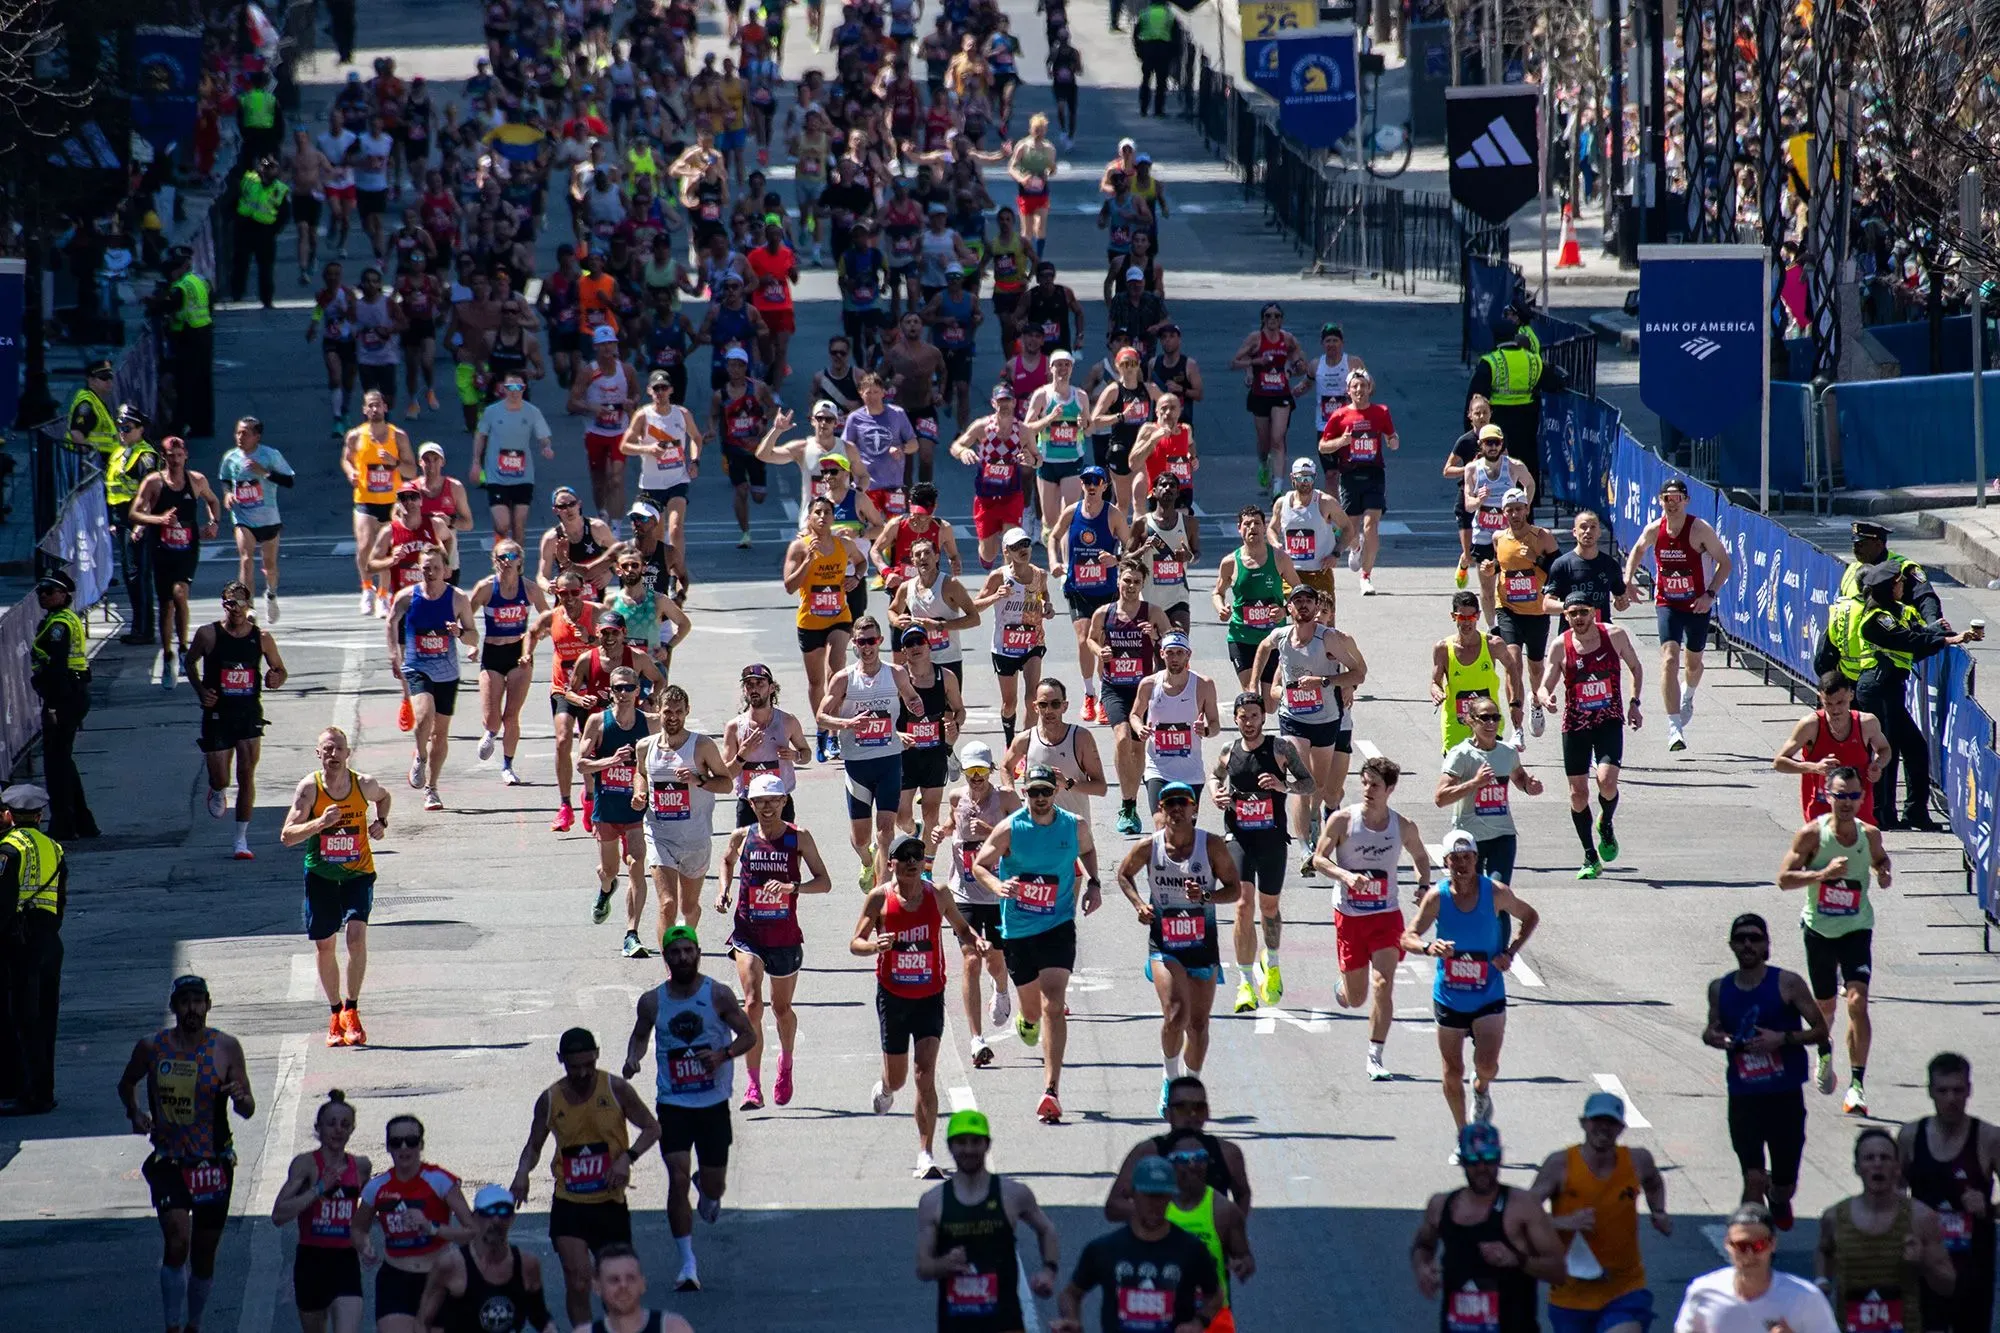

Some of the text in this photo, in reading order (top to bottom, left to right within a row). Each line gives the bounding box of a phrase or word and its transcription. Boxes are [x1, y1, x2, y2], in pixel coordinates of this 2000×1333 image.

[1257, 11, 1298, 37] 26
[1645, 322, 1756, 333] BANK OF AMERICA
[1291, 538, 1309, 549] 4741
[1080, 565, 1102, 578] 2708
[1158, 562, 1179, 574] 3959
[1666, 577, 1689, 589] 2716
[815, 593, 838, 606] 5415
[499, 606, 521, 619] 5472
[1009, 632, 1032, 644] 3712
[1110, 631, 1143, 640] MILL CITY
[1111, 639, 1143, 648] RUNNING
[1115, 659, 1137, 673] 3327
[227, 671, 250, 684] 4270
[1582, 682, 1606, 697] 4870
[913, 725, 935, 737] 6653
[1161, 733, 1185, 745] 1150
[607, 767, 632, 780] 4435
[750, 850, 789, 861] MILL CITY
[750, 862, 788, 872] RUNNING
[1024, 884, 1052, 901] 3217
[1169, 919, 1197, 935] 1091
[897, 954, 926, 969] 5526
